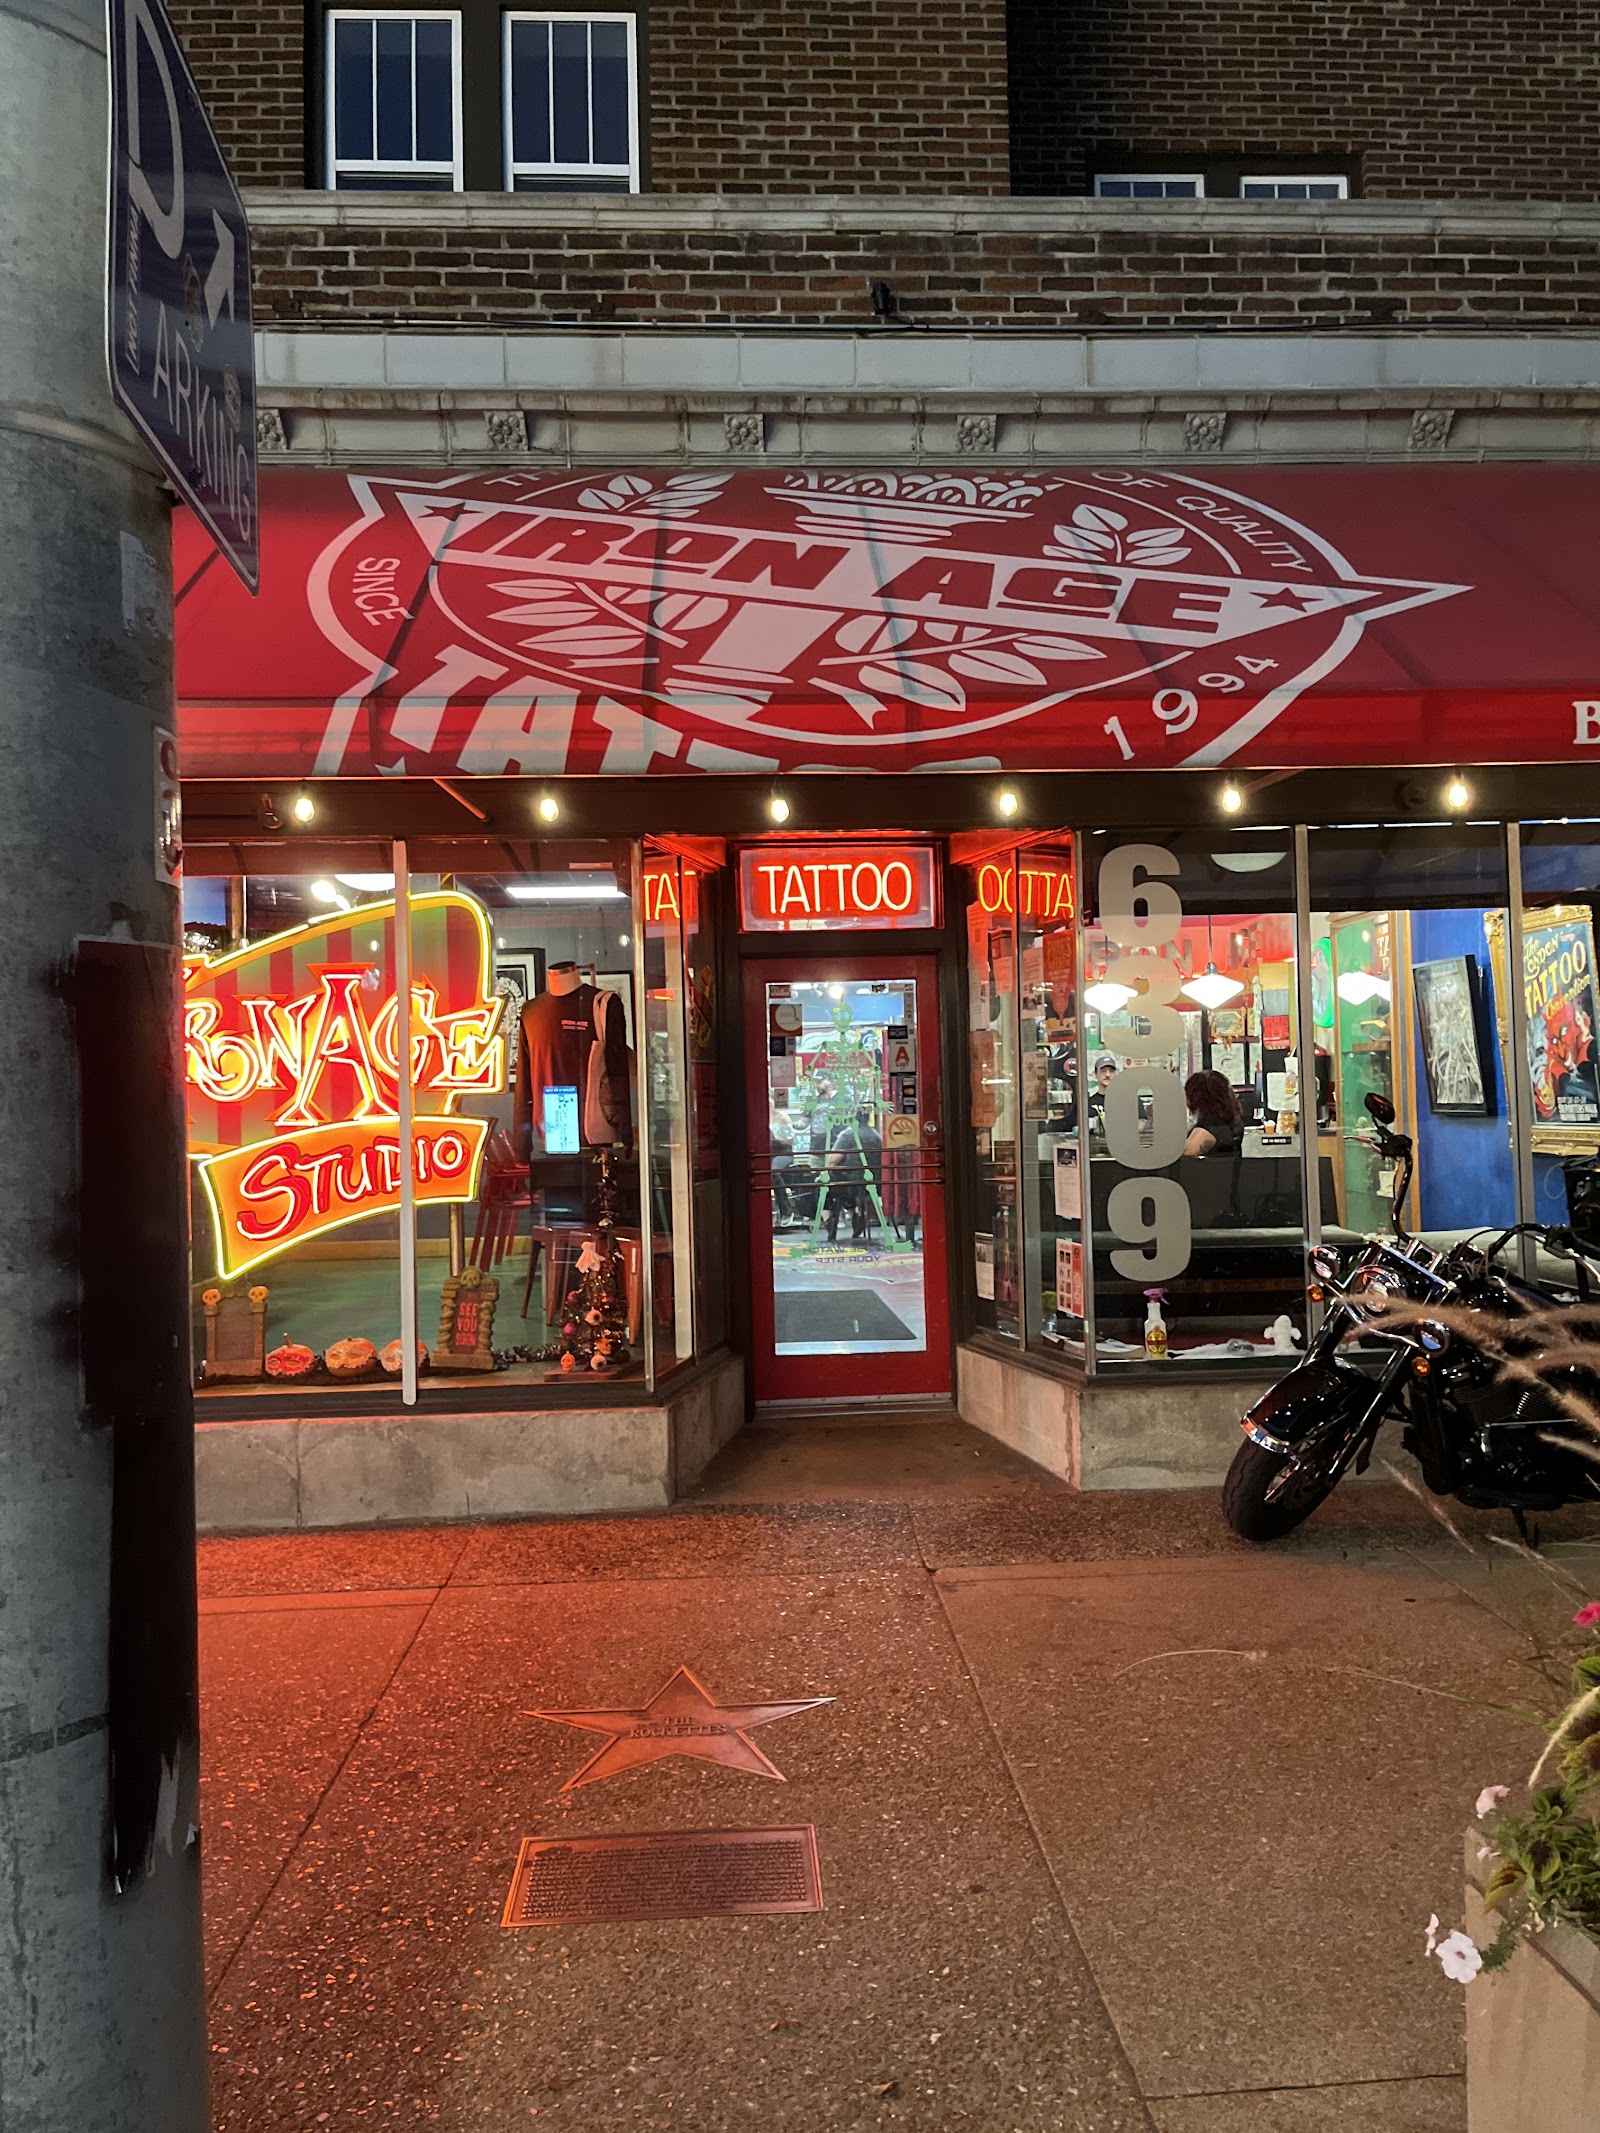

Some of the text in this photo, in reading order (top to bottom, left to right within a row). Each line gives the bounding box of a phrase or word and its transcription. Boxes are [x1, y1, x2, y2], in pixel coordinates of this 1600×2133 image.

[1091, 470, 1313, 573] OF QUALITY
[351, 556, 416, 627] SINCE
[443, 509, 1238, 634] IRON AGE
[1102, 652, 1279, 761] 1994
[757, 860, 914, 916] TATTOO
[1524, 940, 1587, 1019] TATTOO
[895, 1046, 910, 1062] A
[1097, 843, 1193, 1283] 6309
[236, 1130, 472, 1242] STUDIO
[457, 1316, 478, 1332] YOU
[459, 1302, 478, 1316] SEE
[629, 1724, 728, 1739] ROCKETTES
